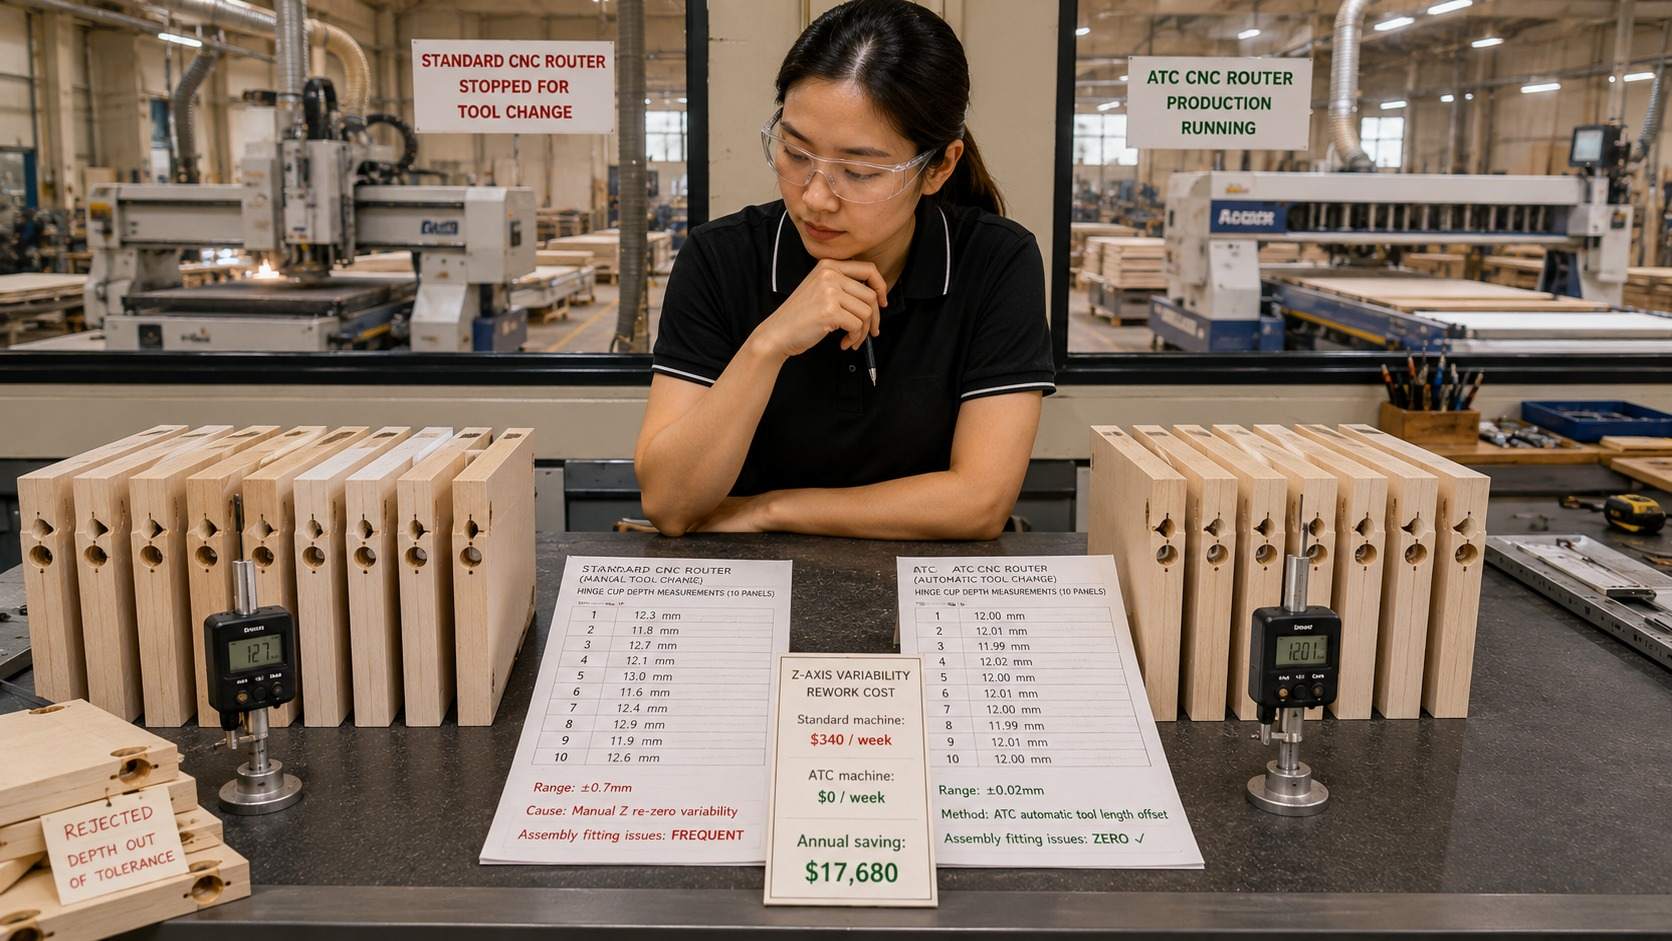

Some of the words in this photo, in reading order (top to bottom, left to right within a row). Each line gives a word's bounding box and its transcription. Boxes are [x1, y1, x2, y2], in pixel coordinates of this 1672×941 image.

[422, 54, 504, 67] STANDARD
[509, 54, 540, 68] CNC
[545, 55, 605, 68] ROUTER
[1147, 70, 1179, 84] ATC
[1186, 71, 1220, 84] CNC
[1227, 71, 1293, 85] ROUTER
[460, 80, 532, 93] STOPPED
[538, 80, 568, 93] FOR
[1167, 96, 1271, 110] PRODUCTION
[458, 105, 500, 118] TOOL
[506, 105, 572, 119] CHANGE
[1182, 121, 1256, 135] RUNNING
[653, 566, 680, 575] CNC
[683, 566, 732, 575] ROUTER
[977, 565, 1000, 573] CNC
[914, 576, 977, 584] (AUTOMATIC
[577, 588, 604, 596] HINGE
[607, 588, 624, 596] CUP
[627, 588, 654, 596] DEPTH
[657, 588, 725, 597] MEASUREMENTS
[727, 588, 740, 597] (10
[1059, 588, 1071, 596] (10
[635, 611, 656, 620] 12.3
[975, 611, 1001, 620] 12.00
[587, 625, 594, 634] 2
[633, 626, 653, 635] 11.8
[936, 627, 942, 635] 2
[977, 627, 1002, 636] 12.01
[584, 640, 591, 649] 3
[630, 641, 651, 649] 12.7
[938, 642, 944, 651] 3
[979, 642, 1005, 651] 11.99
[581, 656, 587, 664] 4
[627, 656, 647, 665] 12.1
[939, 657, 945, 666] 4
[981, 656, 1007, 666] 12.02
[577, 671, 584, 680] 5
[624, 672, 646, 681] 13.0
[792, 670, 832, 680] Z-AXIS
[836, 670, 910, 680] VARIABILITY
[941, 673, 947, 682] 5
[982, 673, 1010, 682] 12.00
[573, 687, 580, 696] 6
[621, 688, 642, 697] 11.6
[807, 687, 858, 697] REWORK
[864, 688, 895, 697] COST
[942, 689, 949, 698] 6
[985, 689, 1011, 698] 12.01
[571, 703, 577, 712] 7
[618, 704, 640, 712] 12.4
[944, 705, 950, 714] 7
[987, 705, 1015, 714] 12.00
[565, 720, 572, 728] 8
[615, 720, 637, 729] 12.9
[797, 714, 848, 724] Standard
[854, 715, 904, 725] machine:
[946, 721, 952, 729] 8
[989, 721, 1018, 730] 11.99
[562, 736, 569, 745] 9
[612, 736, 634, 745] 11.9
[811, 733, 844, 746] $340
[858, 734, 892, 745] week
[947, 737, 954, 746] 9
[992, 737, 1020, 747] 12.01
[555, 753, 567, 762] 10
[608, 753, 631, 762] 12.6
[947, 754, 959, 763] 10
[995, 754, 1025, 764] 12.00
[809, 770, 833, 781] ATC
[839, 770, 894, 781] machine:
[534, 782, 575, 795] Range:
[581, 783, 632, 792] ±0.7mm
[939, 785, 979, 798] Range:
[987, 785, 1044, 795] ±0.02mm
[818, 790, 835, 804] $0
[850, 791, 885, 803] week
[527, 805, 567, 815] Cause:
[572, 805, 615, 816] Manual
[619, 806, 628, 816] Z
[681, 806, 737, 819] variability
[942, 809, 988, 819] Method:
[994, 809, 1016, 819] ATC
[1021, 810, 1072, 819] automatic
[1076, 809, 1097, 819] tool
[1100, 809, 1134, 822] length
[1138, 809, 1168, 819] offset
[64, 806, 153, 840] REJECTED
[518, 829, 578, 843] Assembly
[584, 829, 620, 843] fitting
[625, 830, 665, 840] issues:
[672, 830, 744, 841] FREQUENT
[944, 833, 1001, 846] Assembly
[1006, 833, 1042, 847] fitting
[1047, 833, 1087, 844] issues:
[1092, 833, 1129, 844] ZERO
[797, 834, 848, 847] Annual
[855, 835, 905, 852] saving:
[67, 844, 117, 868] DEPTH
[126, 833, 156, 851] OUT
[70, 874, 87, 889] OF
[95, 850, 176, 882] TOLERANCE
[806, 860, 898, 886] $17,680
